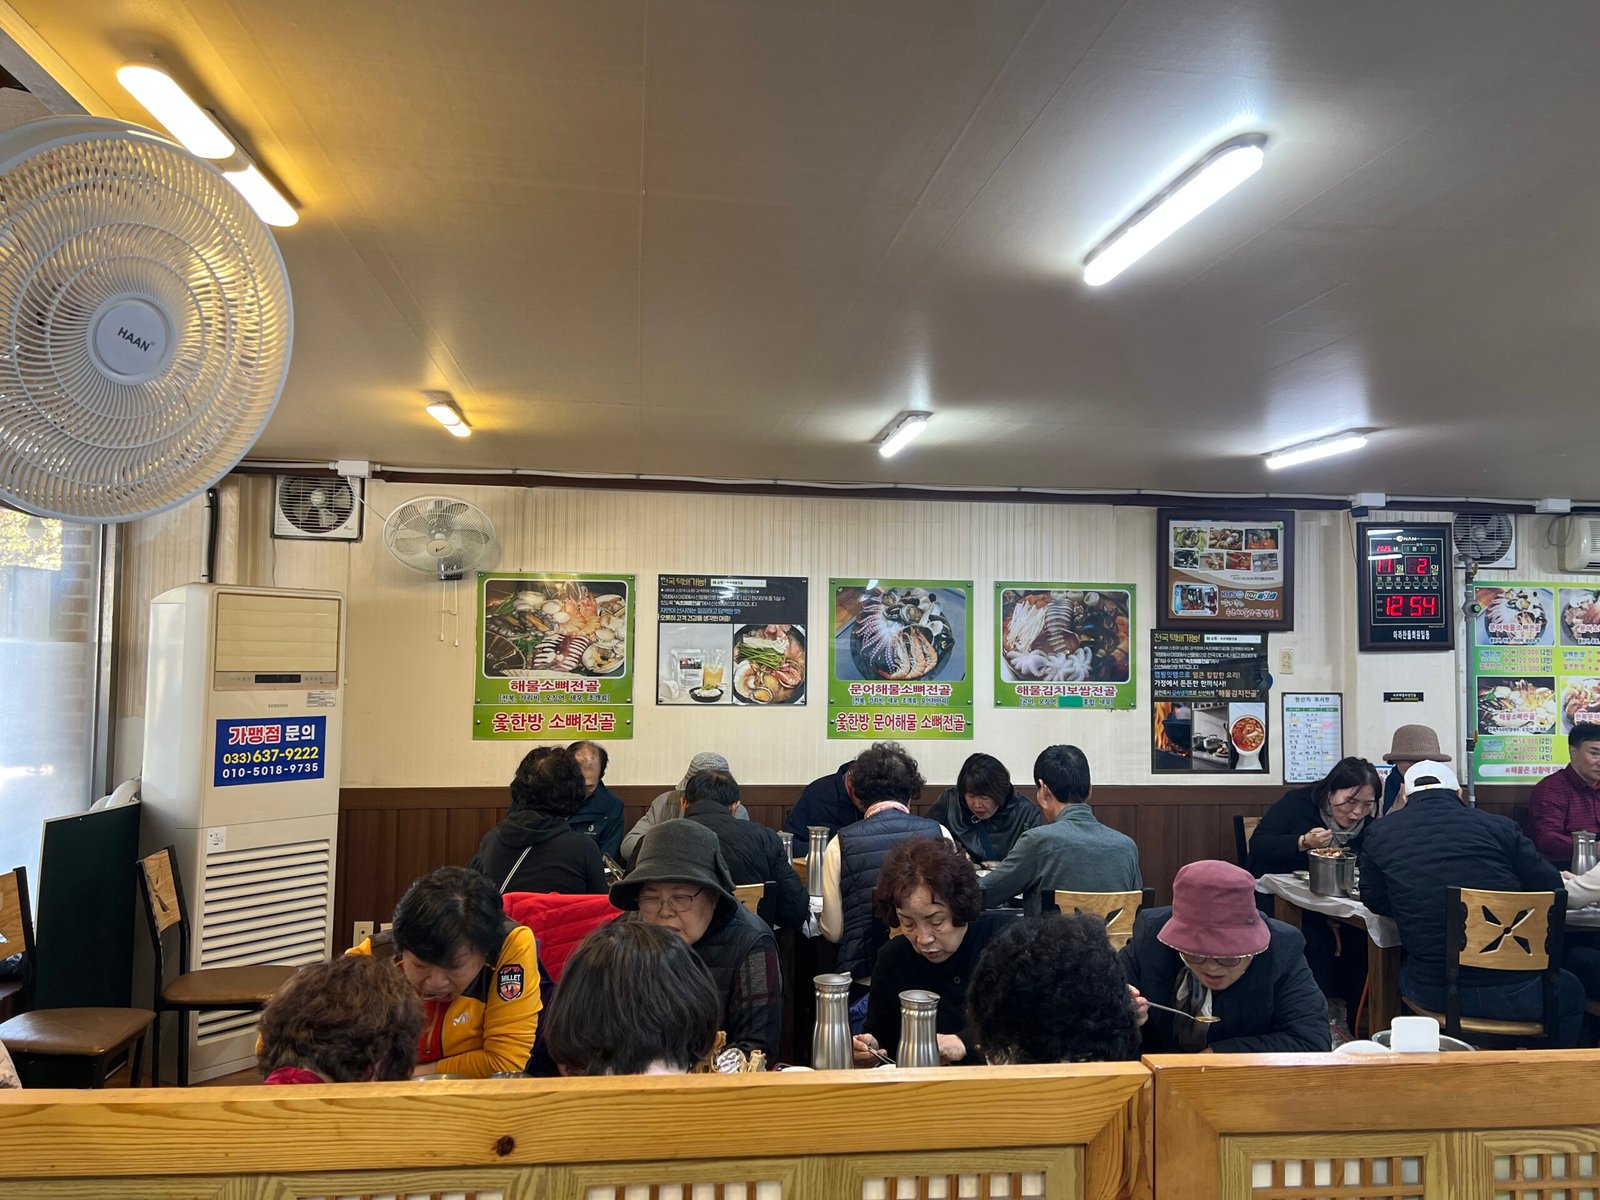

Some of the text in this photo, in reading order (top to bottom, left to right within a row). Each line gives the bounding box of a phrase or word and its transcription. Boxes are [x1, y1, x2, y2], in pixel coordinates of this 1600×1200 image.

[117, 327, 151, 352] HAAN
[1377, 557, 1393, 574] 11
[1417, 558, 1429, 574] 2
[1386, 595, 1404, 616] 12
[1410, 595, 1436, 616] 54
[509, 679, 600, 693] 해물소뼈전골
[849, 683, 953, 697] 문어해물소뼈전골
[1016, 684, 1118, 698] 해물김치보쌈전골
[1154, 679, 1178, 687] 가정에서
[1180, 679, 1198, 687] 든든한
[548, 711, 616, 733] 소뼈전골
[873, 713, 918, 734] 문어해물
[920, 713, 966, 734] 소뼈전골
[229, 724, 316, 745] 가맹점 문의
[223, 746, 319, 764] 033)637-9222
[222, 762, 319, 779] 010-5018-9735
[501, 974, 521, 982] MILLET
